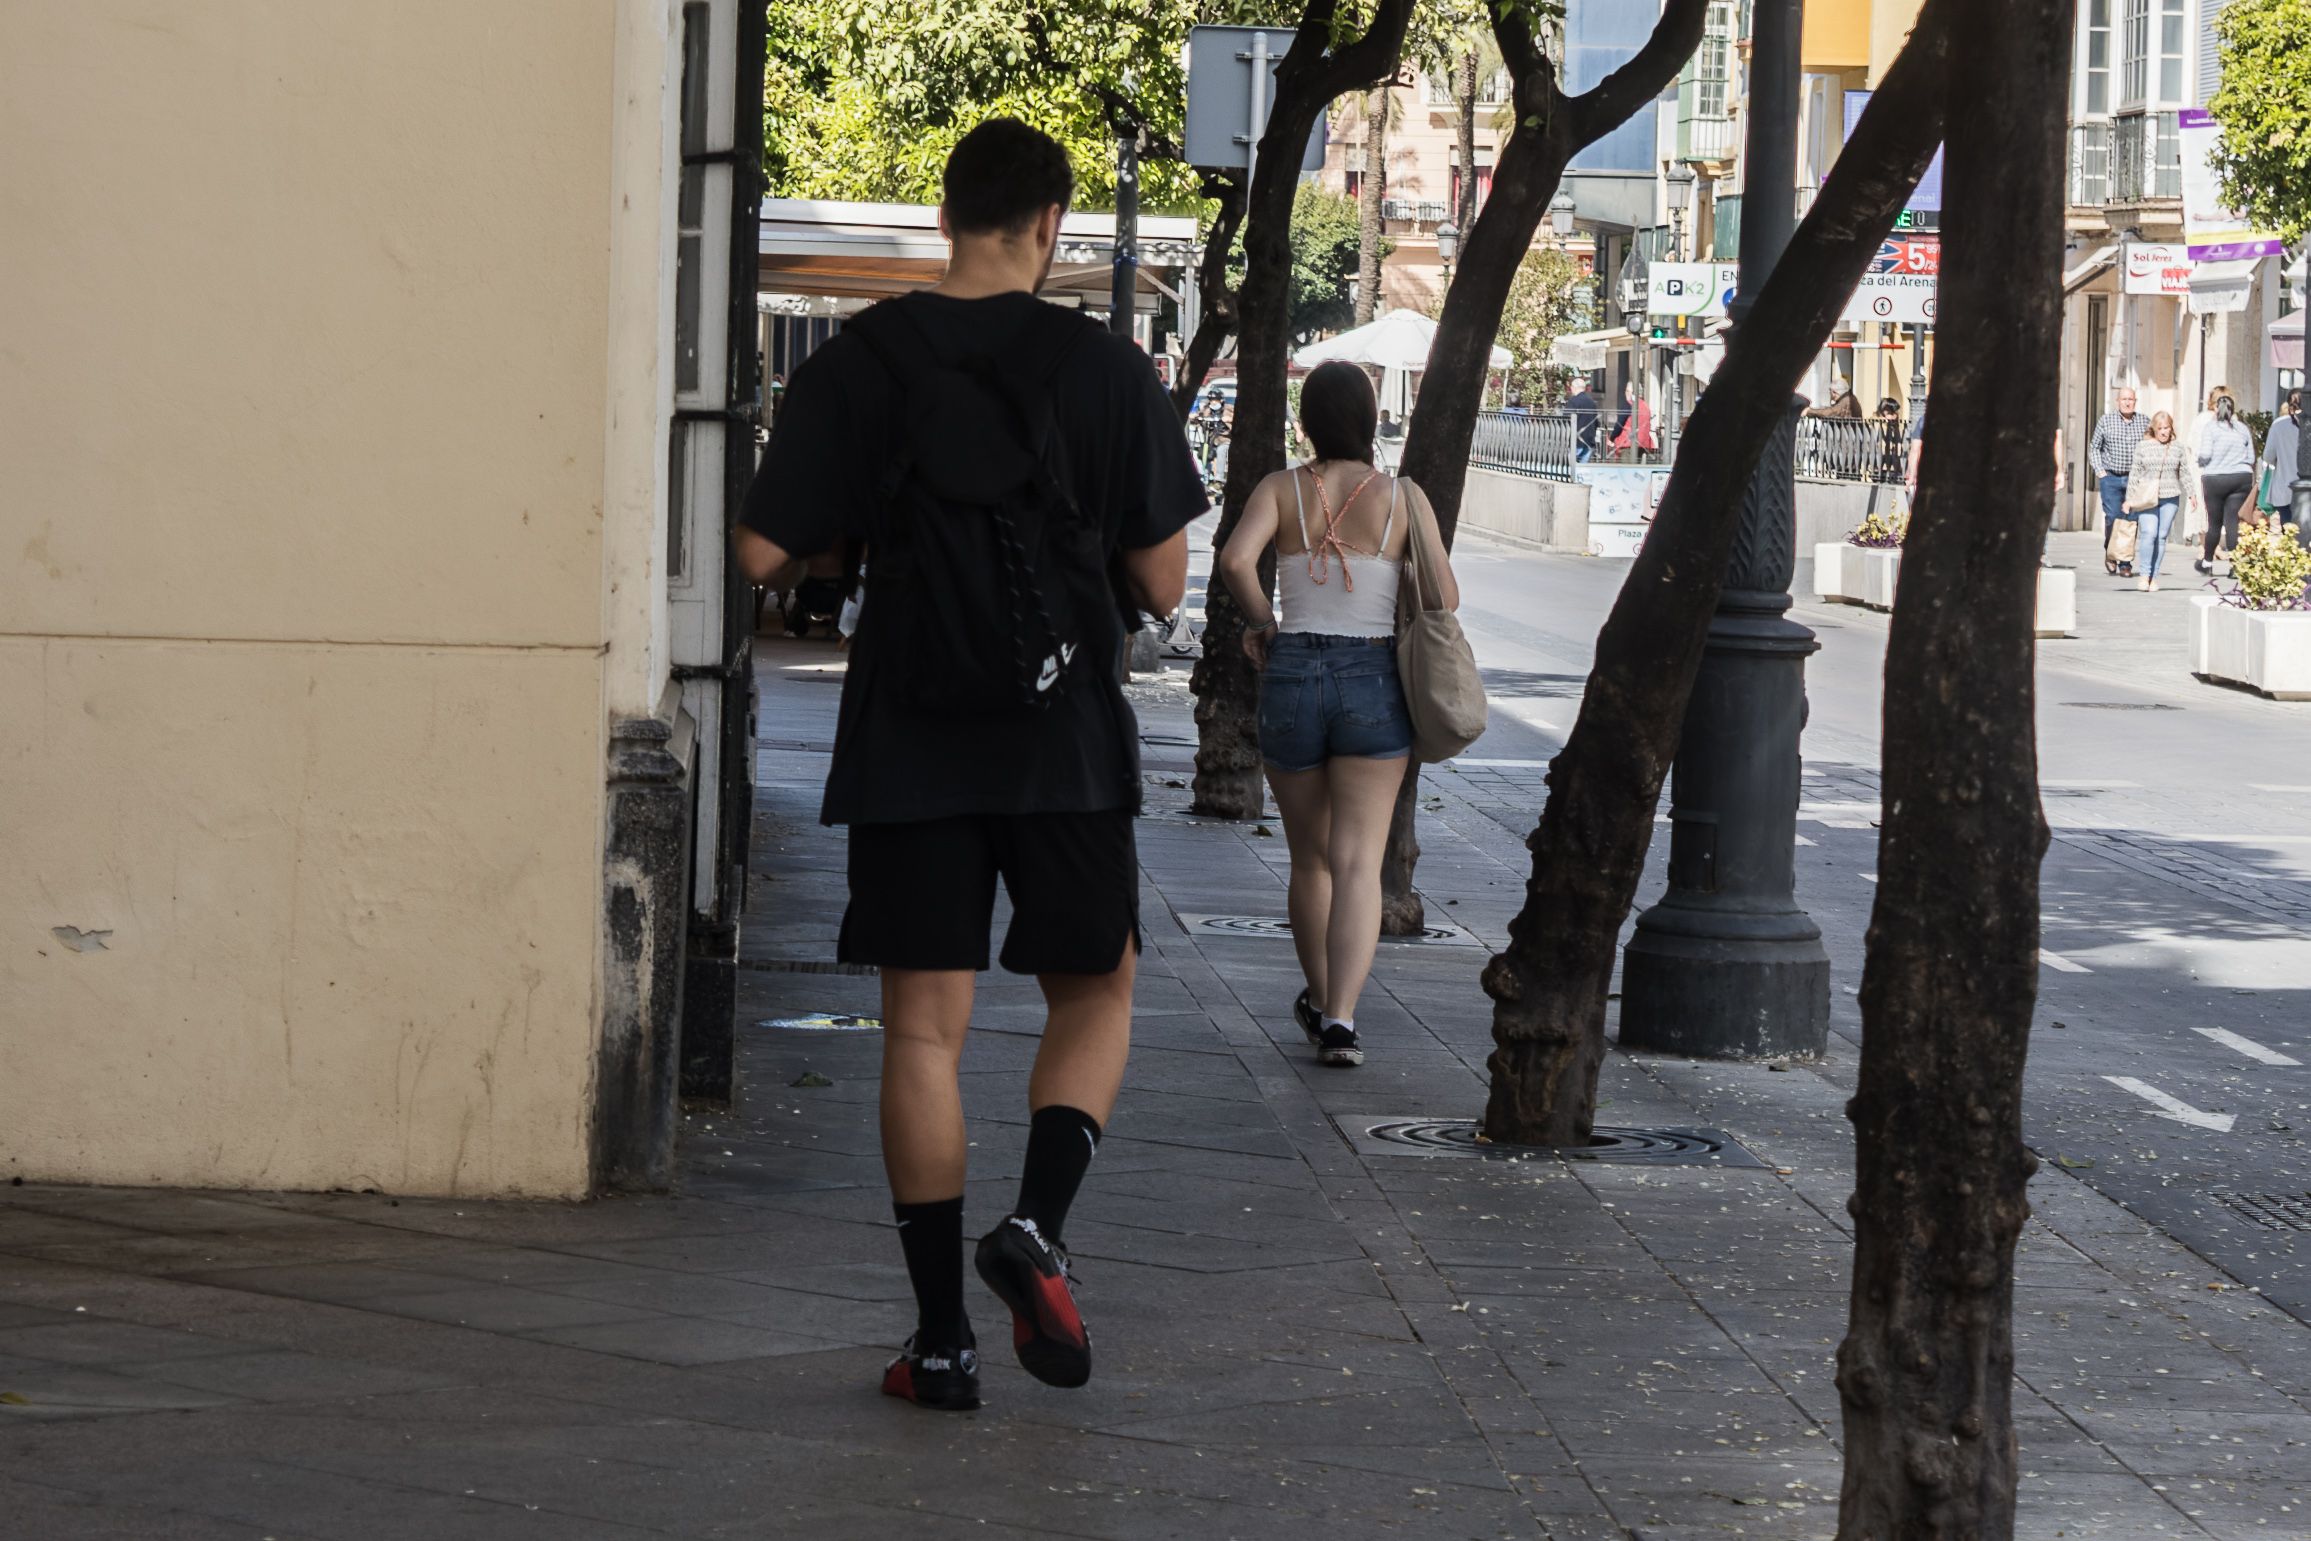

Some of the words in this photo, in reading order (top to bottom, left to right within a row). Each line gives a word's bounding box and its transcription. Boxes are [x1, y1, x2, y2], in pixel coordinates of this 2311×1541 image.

[2133, 253, 2149, 262] Sol
[1878, 276, 1896, 286] del
[1618, 530, 1642, 538] Plaza
